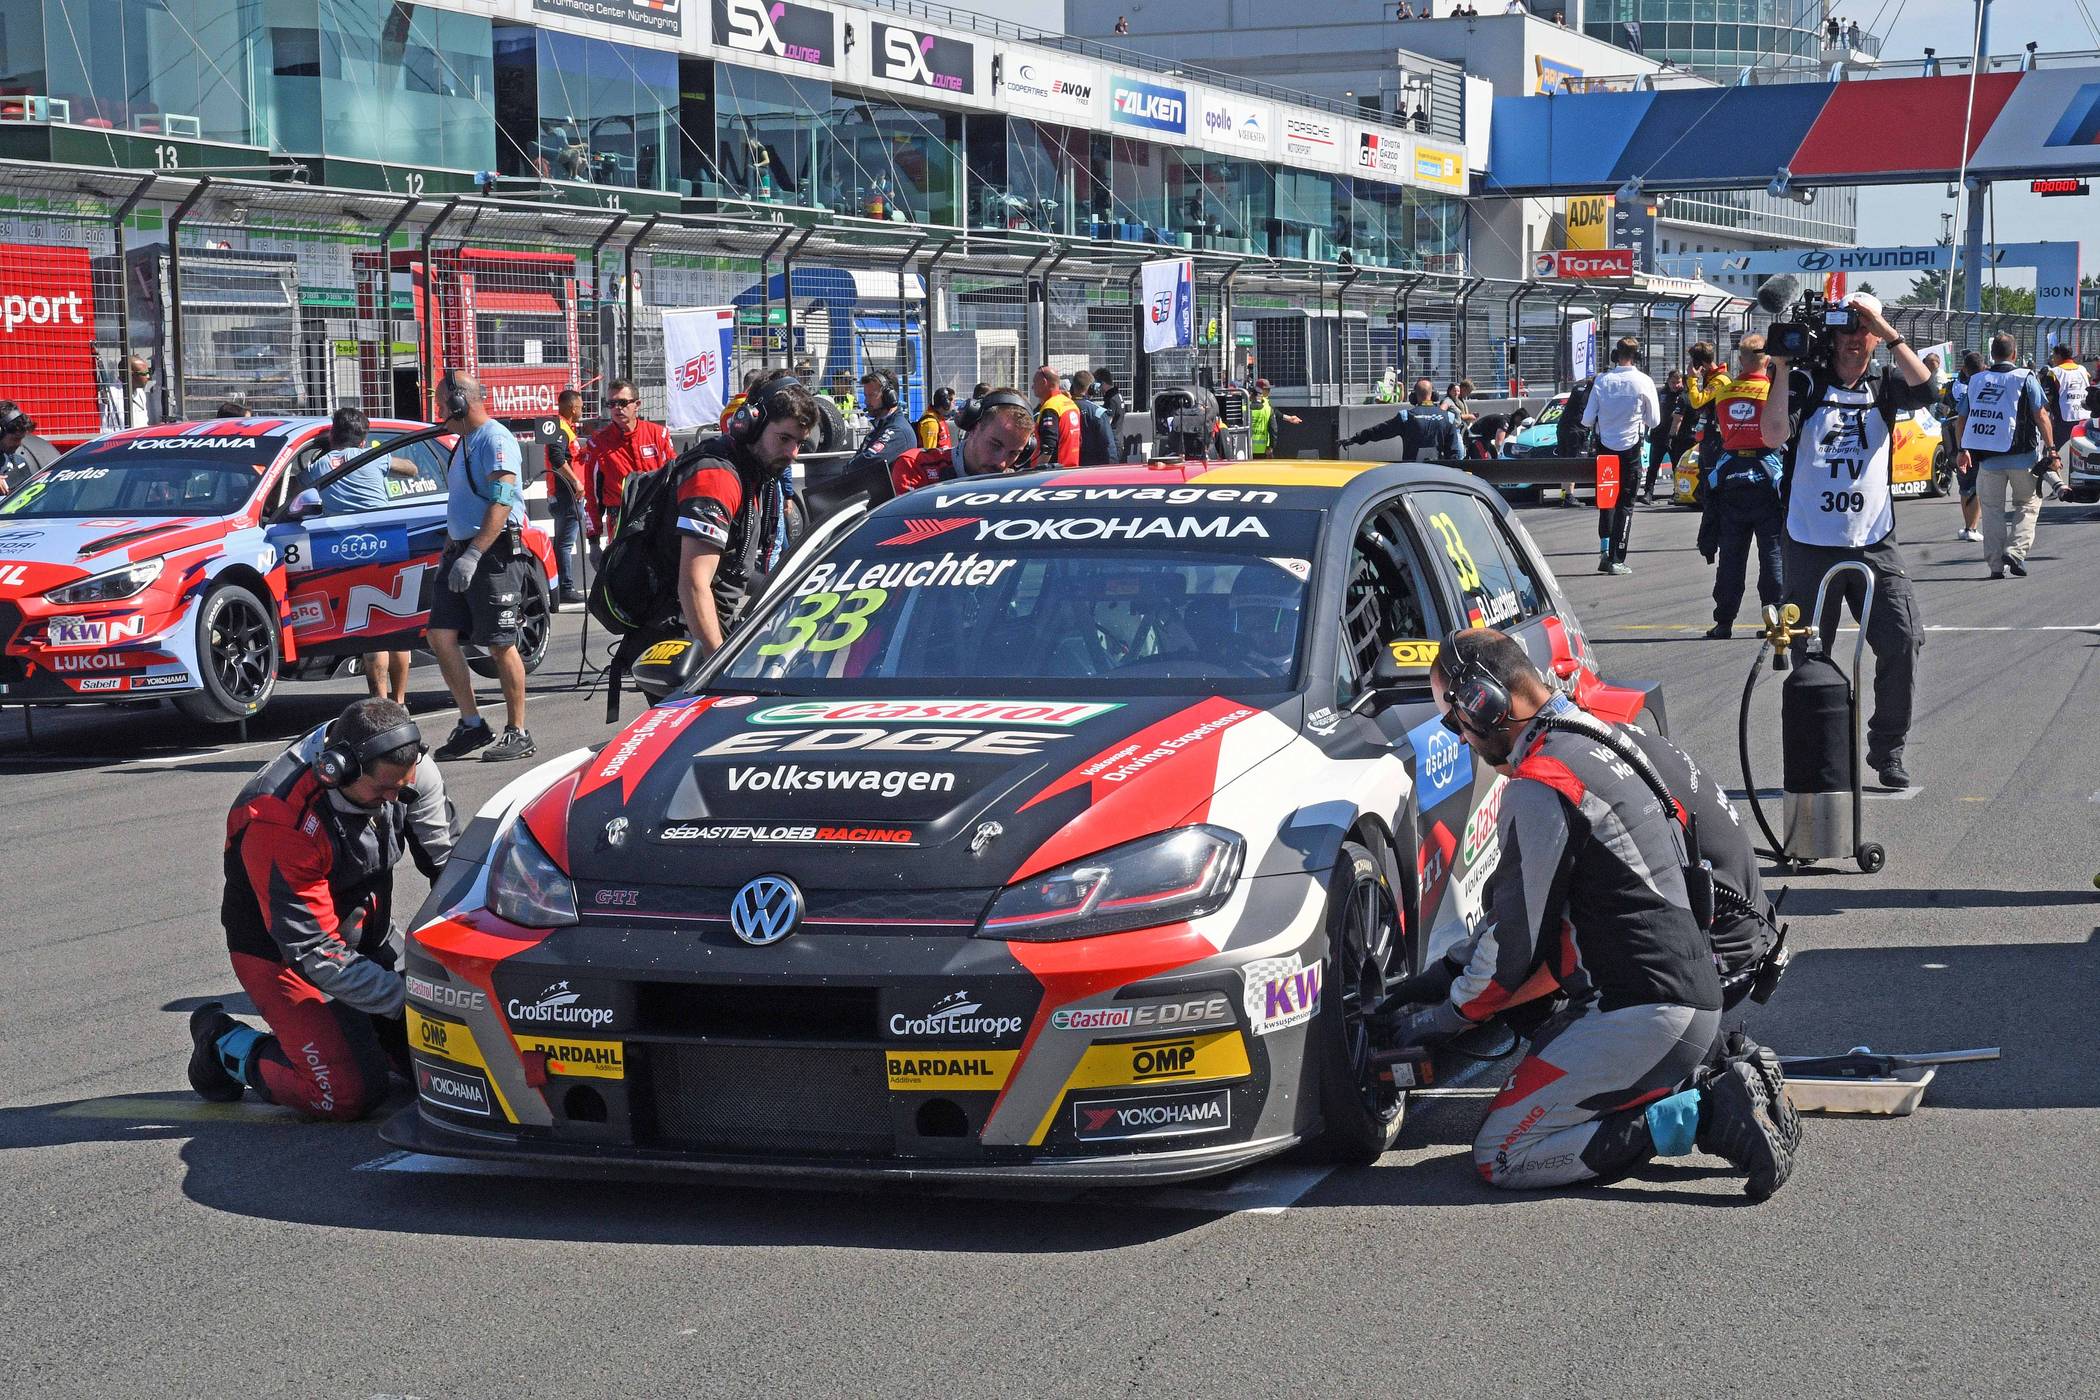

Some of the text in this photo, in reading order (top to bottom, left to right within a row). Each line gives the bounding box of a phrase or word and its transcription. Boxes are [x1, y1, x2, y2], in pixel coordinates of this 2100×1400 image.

[596, 3, 626, 19] Center
[627, 10, 678, 31] Nürburgring
[1060, 81, 1091, 99] AVON
[1206, 107, 1232, 134] apollo
[1288, 119, 1330, 138] PORSCHE
[154, 145, 178, 171] 13
[405, 173, 424, 195] 12
[607, 195, 620, 209] 11
[1569, 198, 1605, 228] ADAC
[1561, 256, 1629, 272] TOTAL
[1840, 251, 1935, 268] HYUNDAI
[2039, 286, 2074, 299] i30 N
[0, 291, 84, 332] port
[1970, 408, 2004, 420] MEDIA
[1971, 423, 1996, 436] 1022
[128, 438, 256, 451] YOKOHAMA
[1825, 458, 1864, 480] TV
[936, 487, 1278, 509] Volkswagen
[1820, 491, 1865, 512] 309
[975, 516, 1271, 541] YOKOHAMA
[285, 544, 301, 564] 8
[332, 539, 387, 554] OSCARO
[1430, 512, 1480, 592] 33
[291, 606, 319, 621] BRC
[757, 587, 888, 656] 33
[59, 622, 103, 642] KW
[54, 653, 125, 671] LUKOIL
[641, 643, 686, 661] OMP
[82, 679, 117, 689] Sabelt
[146, 674, 187, 685] YOKOHAMA
[824, 702, 1081, 721] Castrol
[693, 728, 1075, 757] EDGE
[1102, 707, 1254, 783] Driving Experience
[1080, 744, 1141, 778] Volkswagen
[1425, 741, 1459, 777] OSCARO
[728, 766, 955, 798] Volkswagen
[304, 814, 319, 838] OMP
[1419, 848, 1442, 900] TI
[595, 889, 639, 906] GTI
[411, 980, 487, 1011] Castrol EDGE
[1264, 966, 1321, 1020] KW
[508, 999, 614, 1028] CroisiEurope
[1070, 998, 1228, 1029] Castrol EDGE
[421, 1021, 448, 1047] OMP
[890, 1013, 1022, 1037] CroisiEurope
[889, 1058, 994, 1077] BARDAHL
[1133, 1046, 1196, 1075] OMP
[430, 1075, 484, 1103] YOKOHAMA
[890, 1076, 922, 1085] Additives
[1117, 1101, 1222, 1127] YOKOHAMA
